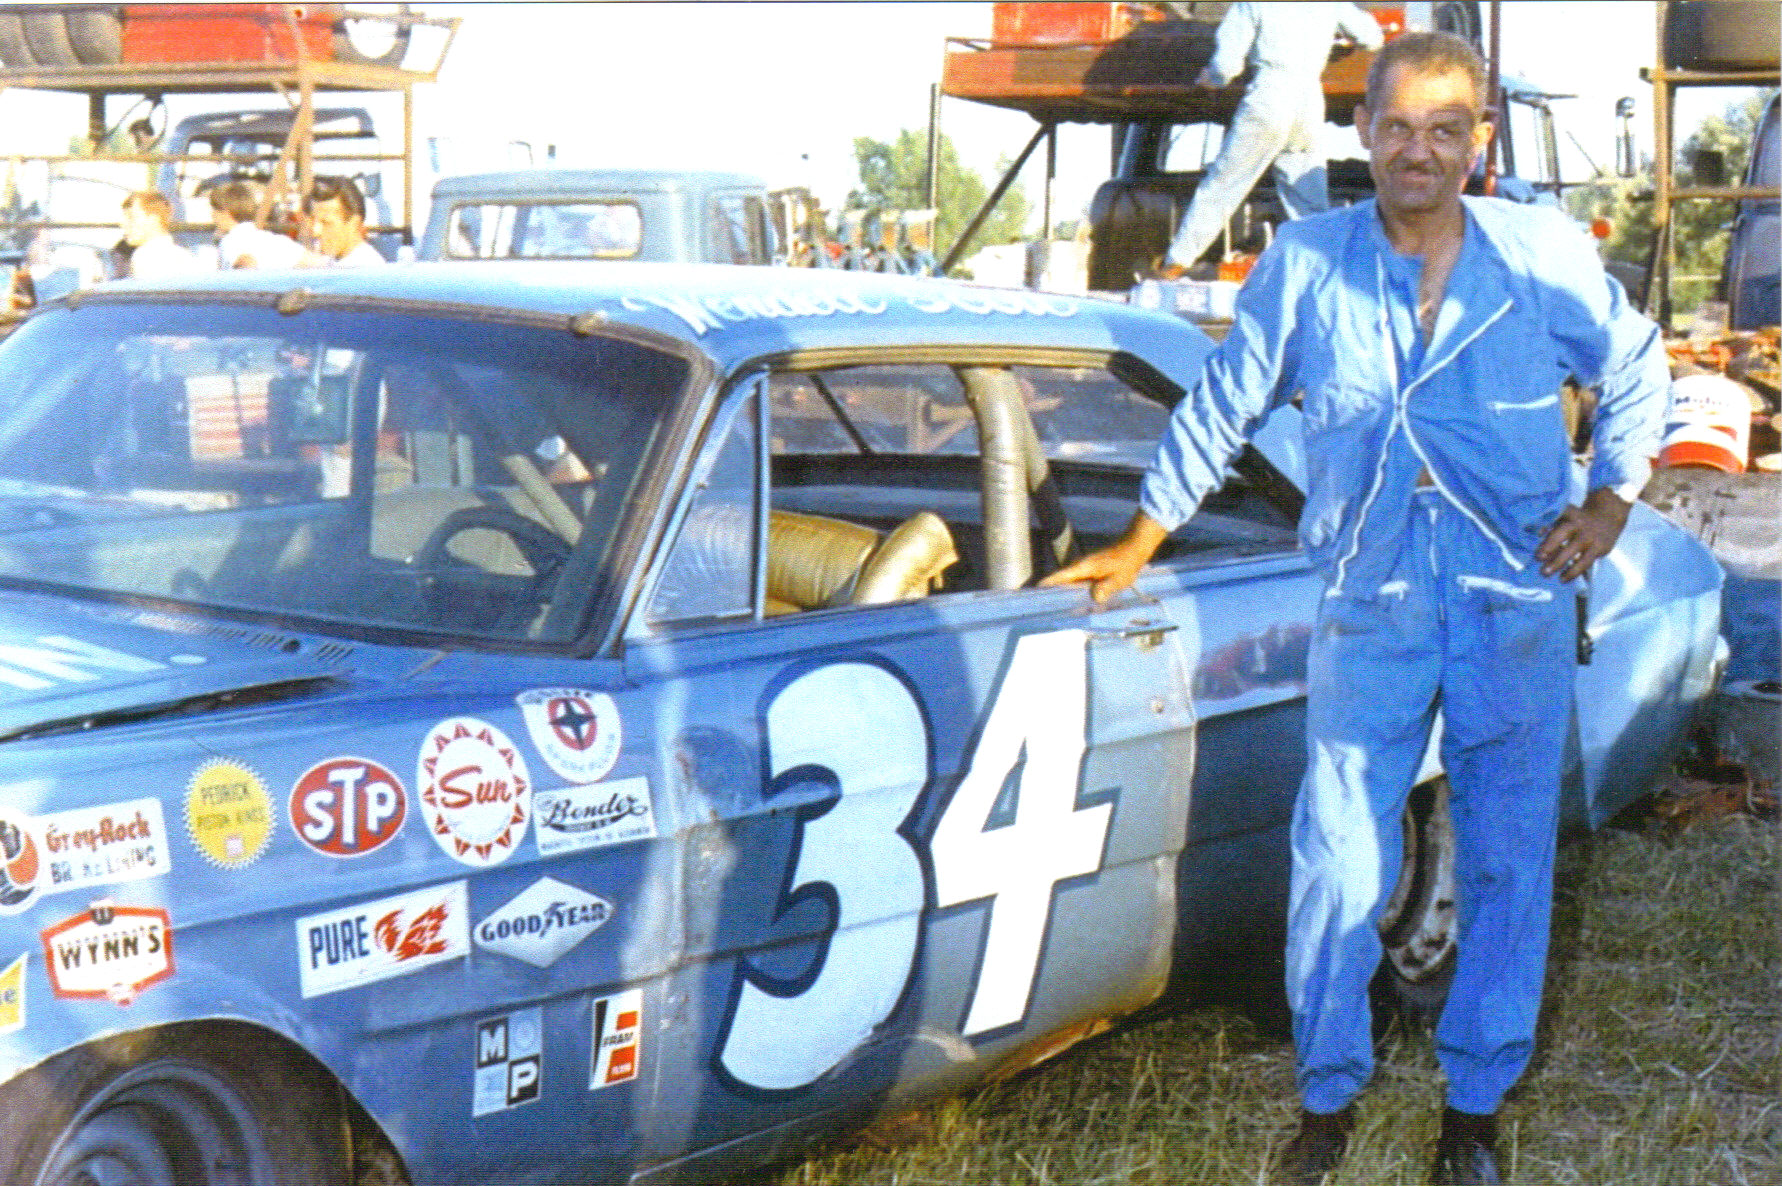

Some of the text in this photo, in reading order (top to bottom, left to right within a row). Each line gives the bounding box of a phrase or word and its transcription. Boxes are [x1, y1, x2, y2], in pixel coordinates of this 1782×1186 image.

[303, 767, 398, 846] STP
[438, 765, 512, 810] Sun
[710, 626, 1117, 1093] 34
[57, 925, 161, 970] WYNN'S
[309, 915, 371, 970] PURE
